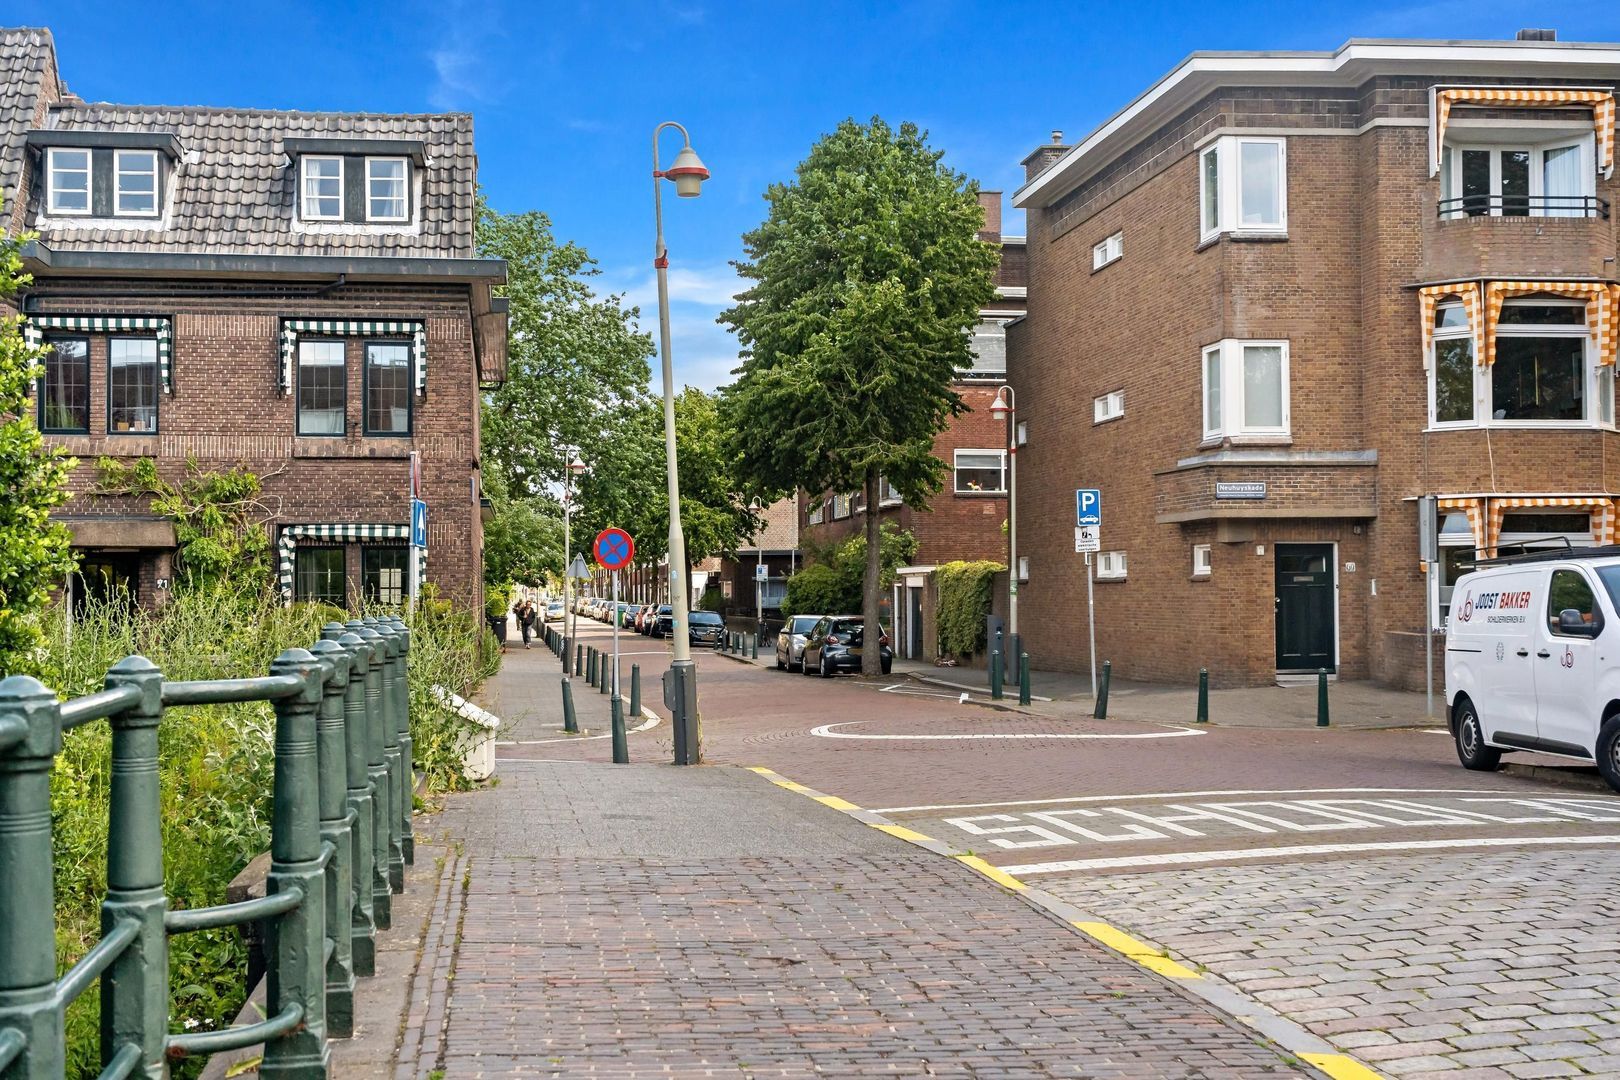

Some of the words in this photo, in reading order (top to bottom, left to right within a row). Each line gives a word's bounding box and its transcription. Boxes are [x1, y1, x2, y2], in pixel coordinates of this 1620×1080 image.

[1219, 484, 1263, 492] Neuhuyskade
[1082, 492, 1095, 512] P
[1475, 592, 1499, 609] JOOST
[1499, 591, 1531, 609] BAKKER
[942, 799, 1575, 849] SCHOOL
